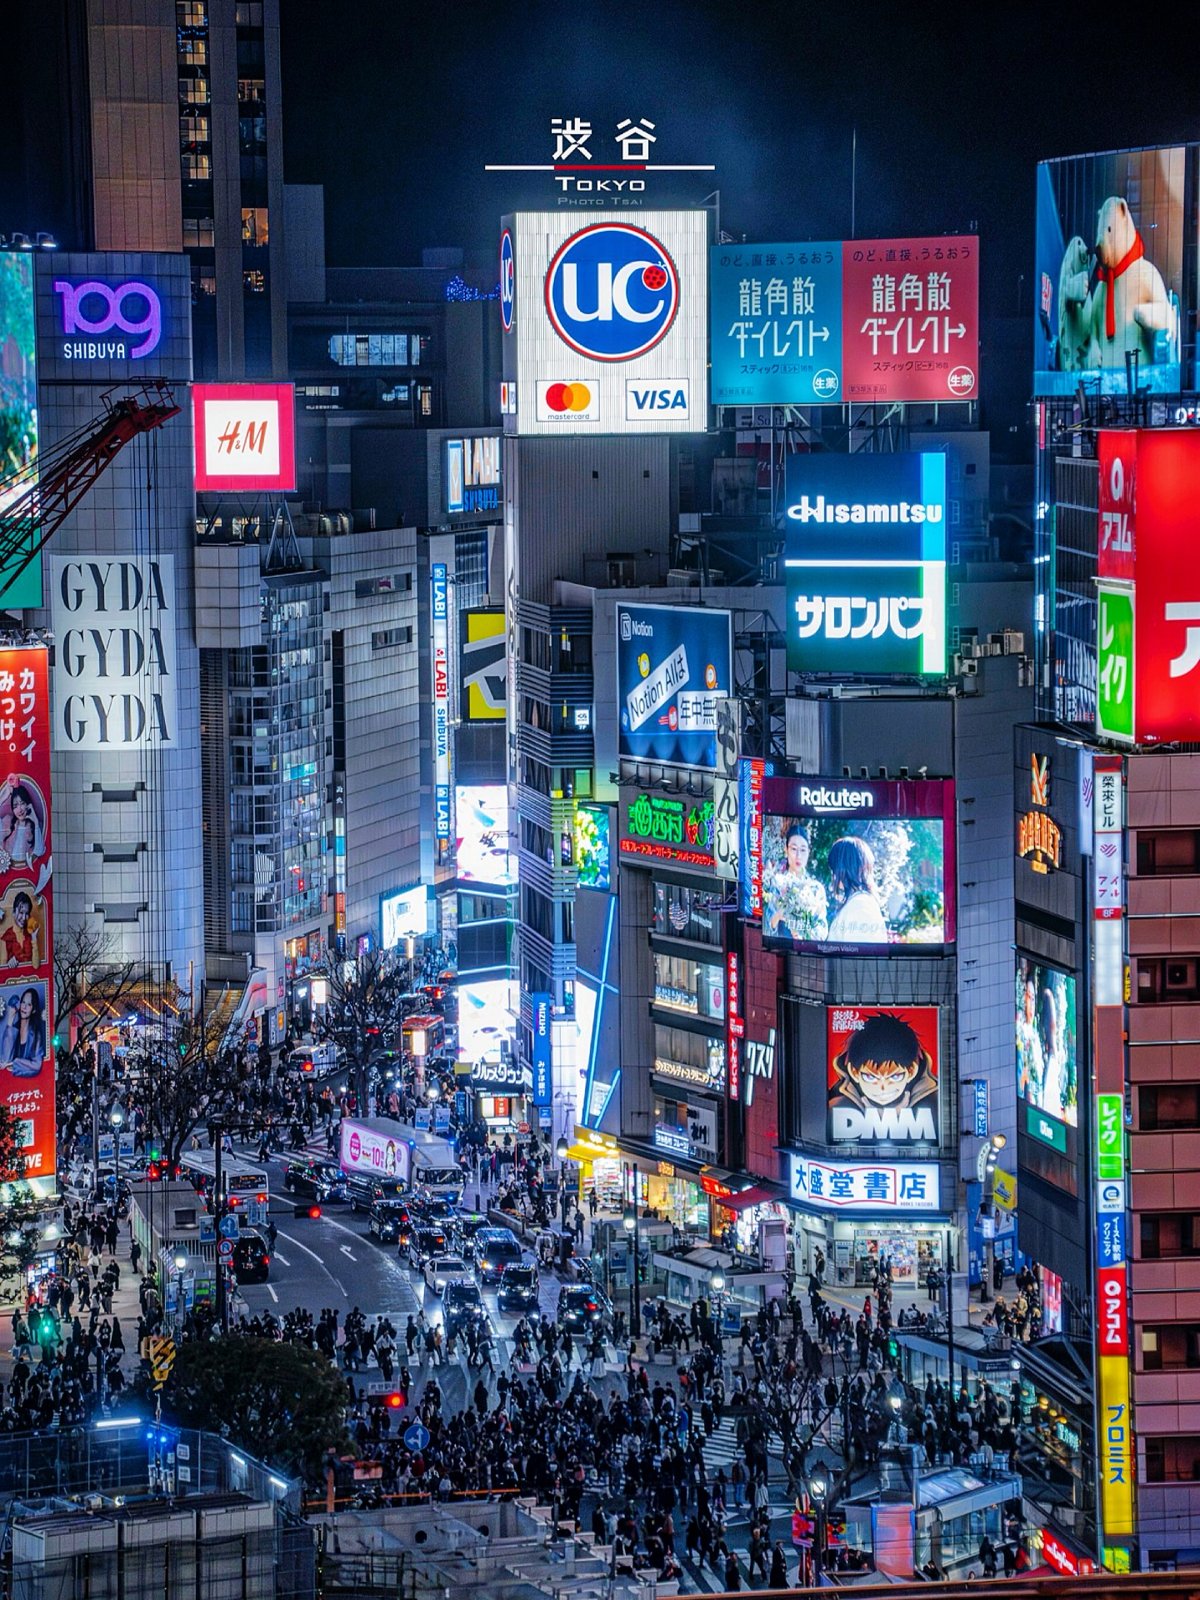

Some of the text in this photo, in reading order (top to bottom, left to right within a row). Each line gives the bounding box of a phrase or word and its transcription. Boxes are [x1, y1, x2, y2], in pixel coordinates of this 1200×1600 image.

[720, 251, 834, 267] のど、直接、うるおう
[853, 247, 971, 262] のど、直接、うるおう
[562, 260, 667, 323] UC
[739, 276, 815, 316] 龍角散
[871, 271, 952, 313] 龍角散
[54, 281, 162, 359] 109
[860, 316, 967, 355] ダイレクト
[63, 343, 126, 359] SHIBUYA
[727, 320, 830, 359] ダイレクト
[814, 377, 838, 390] 生薬
[950, 374, 973, 387] 生薬
[547, 413, 591, 421] mastercard
[629, 389, 687, 411] VISA
[216, 419, 268, 456] H&M
[788, 495, 942, 523] Hisamitsu
[1102, 512, 1132, 552] アコム
[60, 562, 169, 613] GYDA
[434, 581, 446, 619] LABI
[632, 620, 654, 637] Notion
[795, 596, 937, 640] サロンパス
[62, 627, 170, 678] GYDA
[1101, 602, 1128, 705] レイク
[19, 667, 37, 763] カワイイ
[434, 660, 447, 757] LABI SHIBUYA
[630, 680, 665, 718] Notion
[63, 693, 172, 743] GYDA
[800, 786, 874, 810] Rakuten
[436, 800, 448, 836] LABI
[652, 810, 683, 843] 西村
[1019, 811, 1062, 869] MAGNET
[817, 944, 859, 954] Rakuten Vision
[538, 1002, 547, 1037] MIZUHO
[7, 1089, 44, 1103] イチナナで、
[10, 1101, 41, 1115] 叶えよう。
[832, 1107, 937, 1140] DMM
[1101, 1102, 1117, 1145] レイク
[795, 1164, 927, 1200] 大盛堂書店
[1103, 1222, 1112, 1257] クリニック
[1105, 1297, 1122, 1344] アコム
[1107, 1404, 1126, 1484] プロミス
